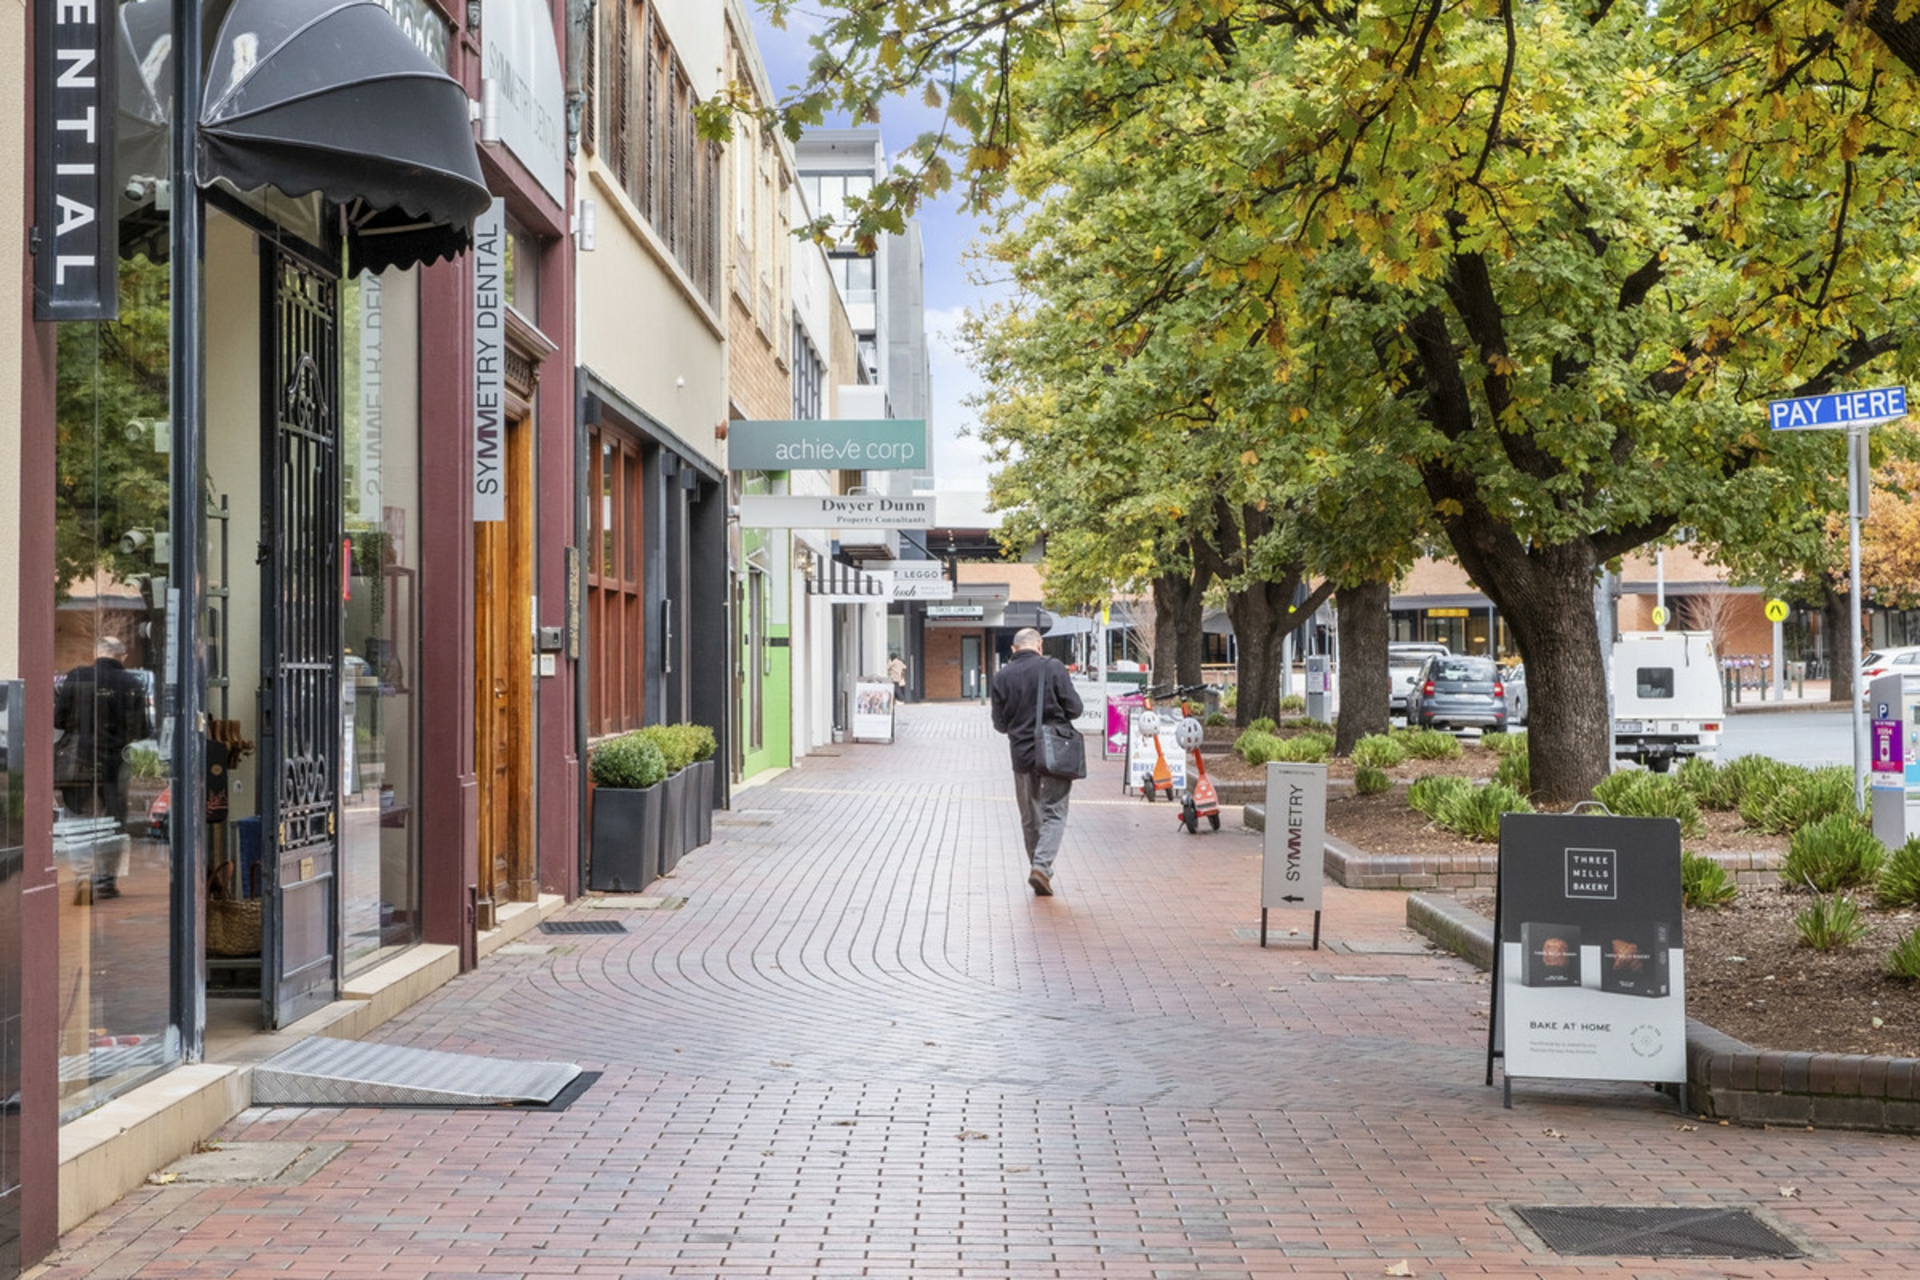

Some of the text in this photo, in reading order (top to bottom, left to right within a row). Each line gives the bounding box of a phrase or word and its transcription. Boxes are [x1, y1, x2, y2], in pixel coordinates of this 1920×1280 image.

[56, 0, 96, 286] ENTIAL
[476, 223, 498, 495] SYMMETRY DENTAL
[1772, 389, 1904, 428] PAY HERE
[775, 438, 915, 463] achieve corp
[821, 499, 926, 513] Dwyer Dunn
[836, 516, 873, 524] Property
[904, 570, 938, 578] LEGGO
[1286, 784, 1303, 882] SYMMETRY
[1573, 855, 1608, 865] THREE
[1573, 870, 1608, 878] MILLS
[1573, 883, 1609, 892] BAKERY
[1530, 1021, 1612, 1032] BAKE AT HOME
